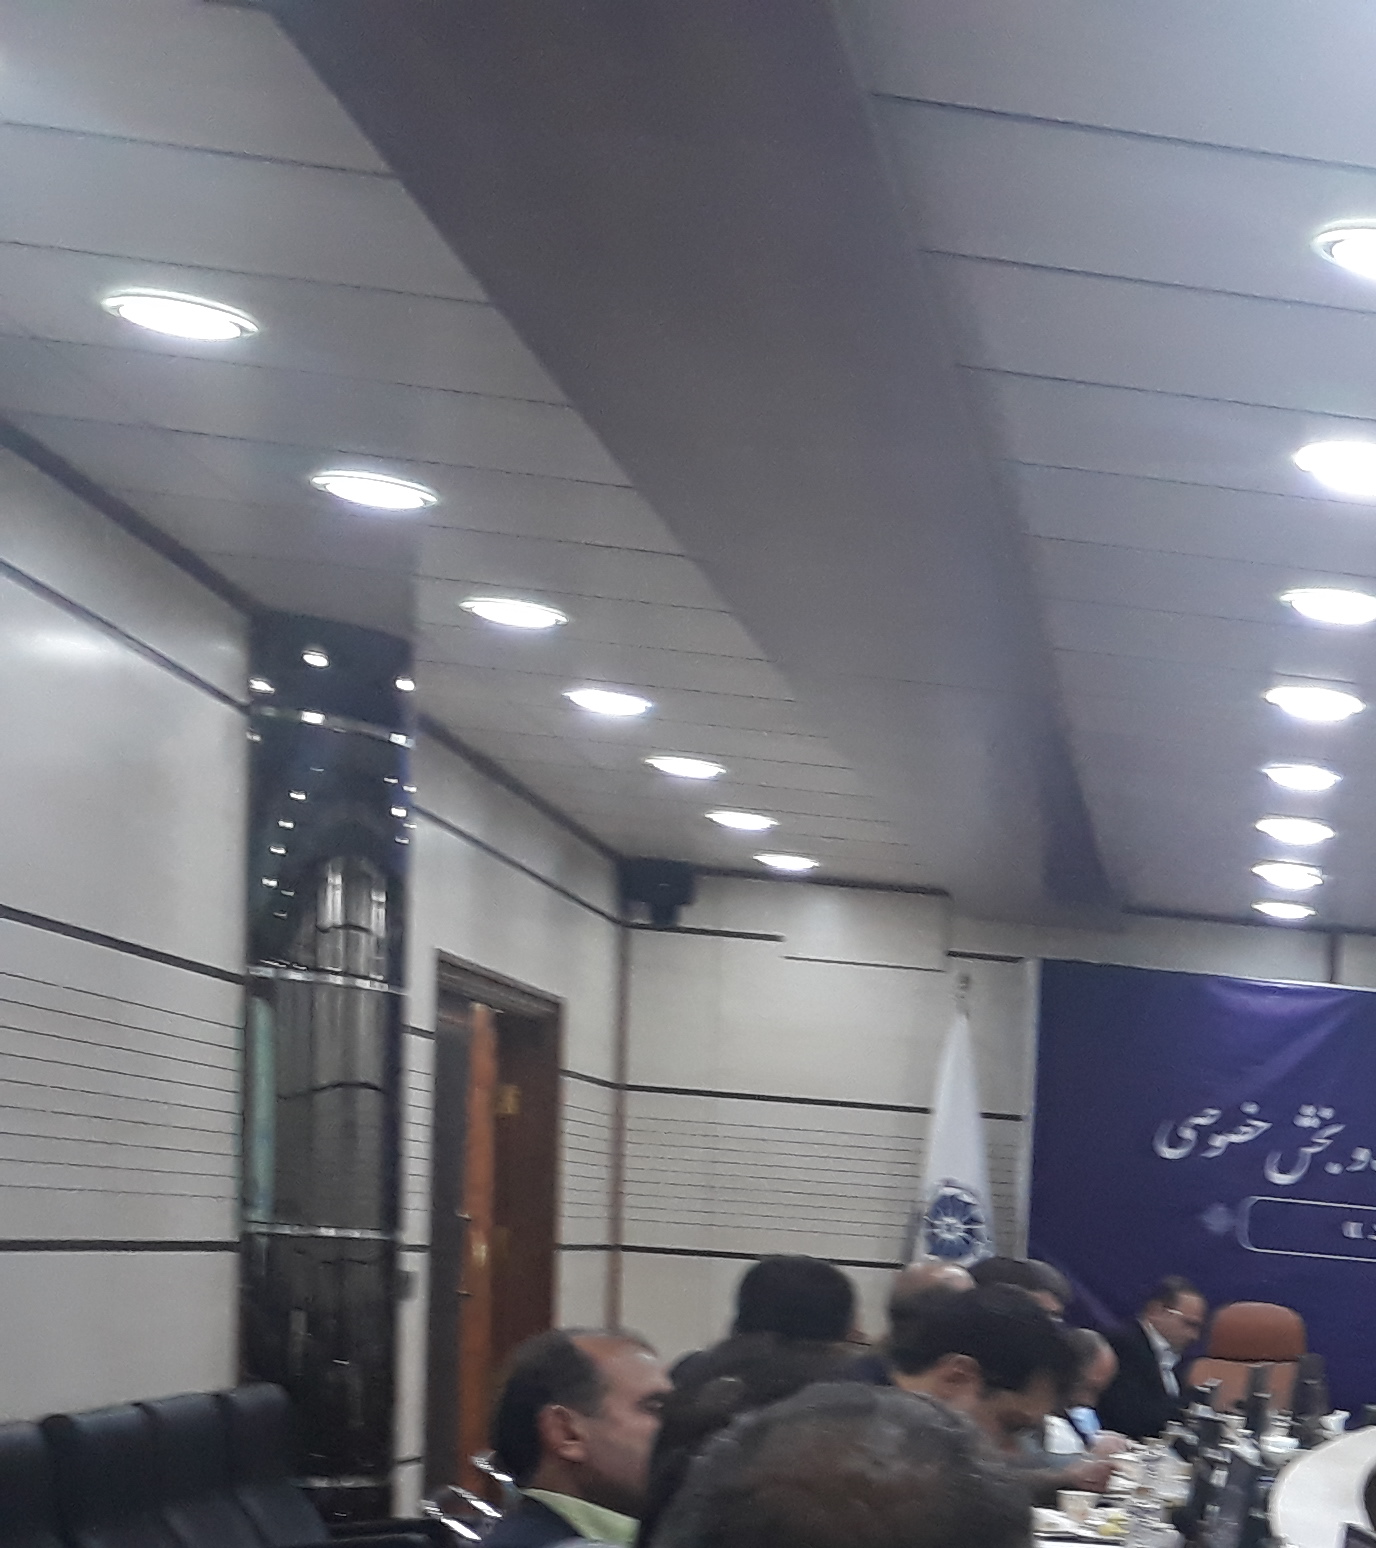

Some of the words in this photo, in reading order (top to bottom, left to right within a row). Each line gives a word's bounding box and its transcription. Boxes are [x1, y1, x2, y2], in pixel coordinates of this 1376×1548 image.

[1152, 1100, 1273, 1159] خصوصی
[1263, 1103, 1348, 1185] بخش
[1345, 1146, 1372, 1172] و
